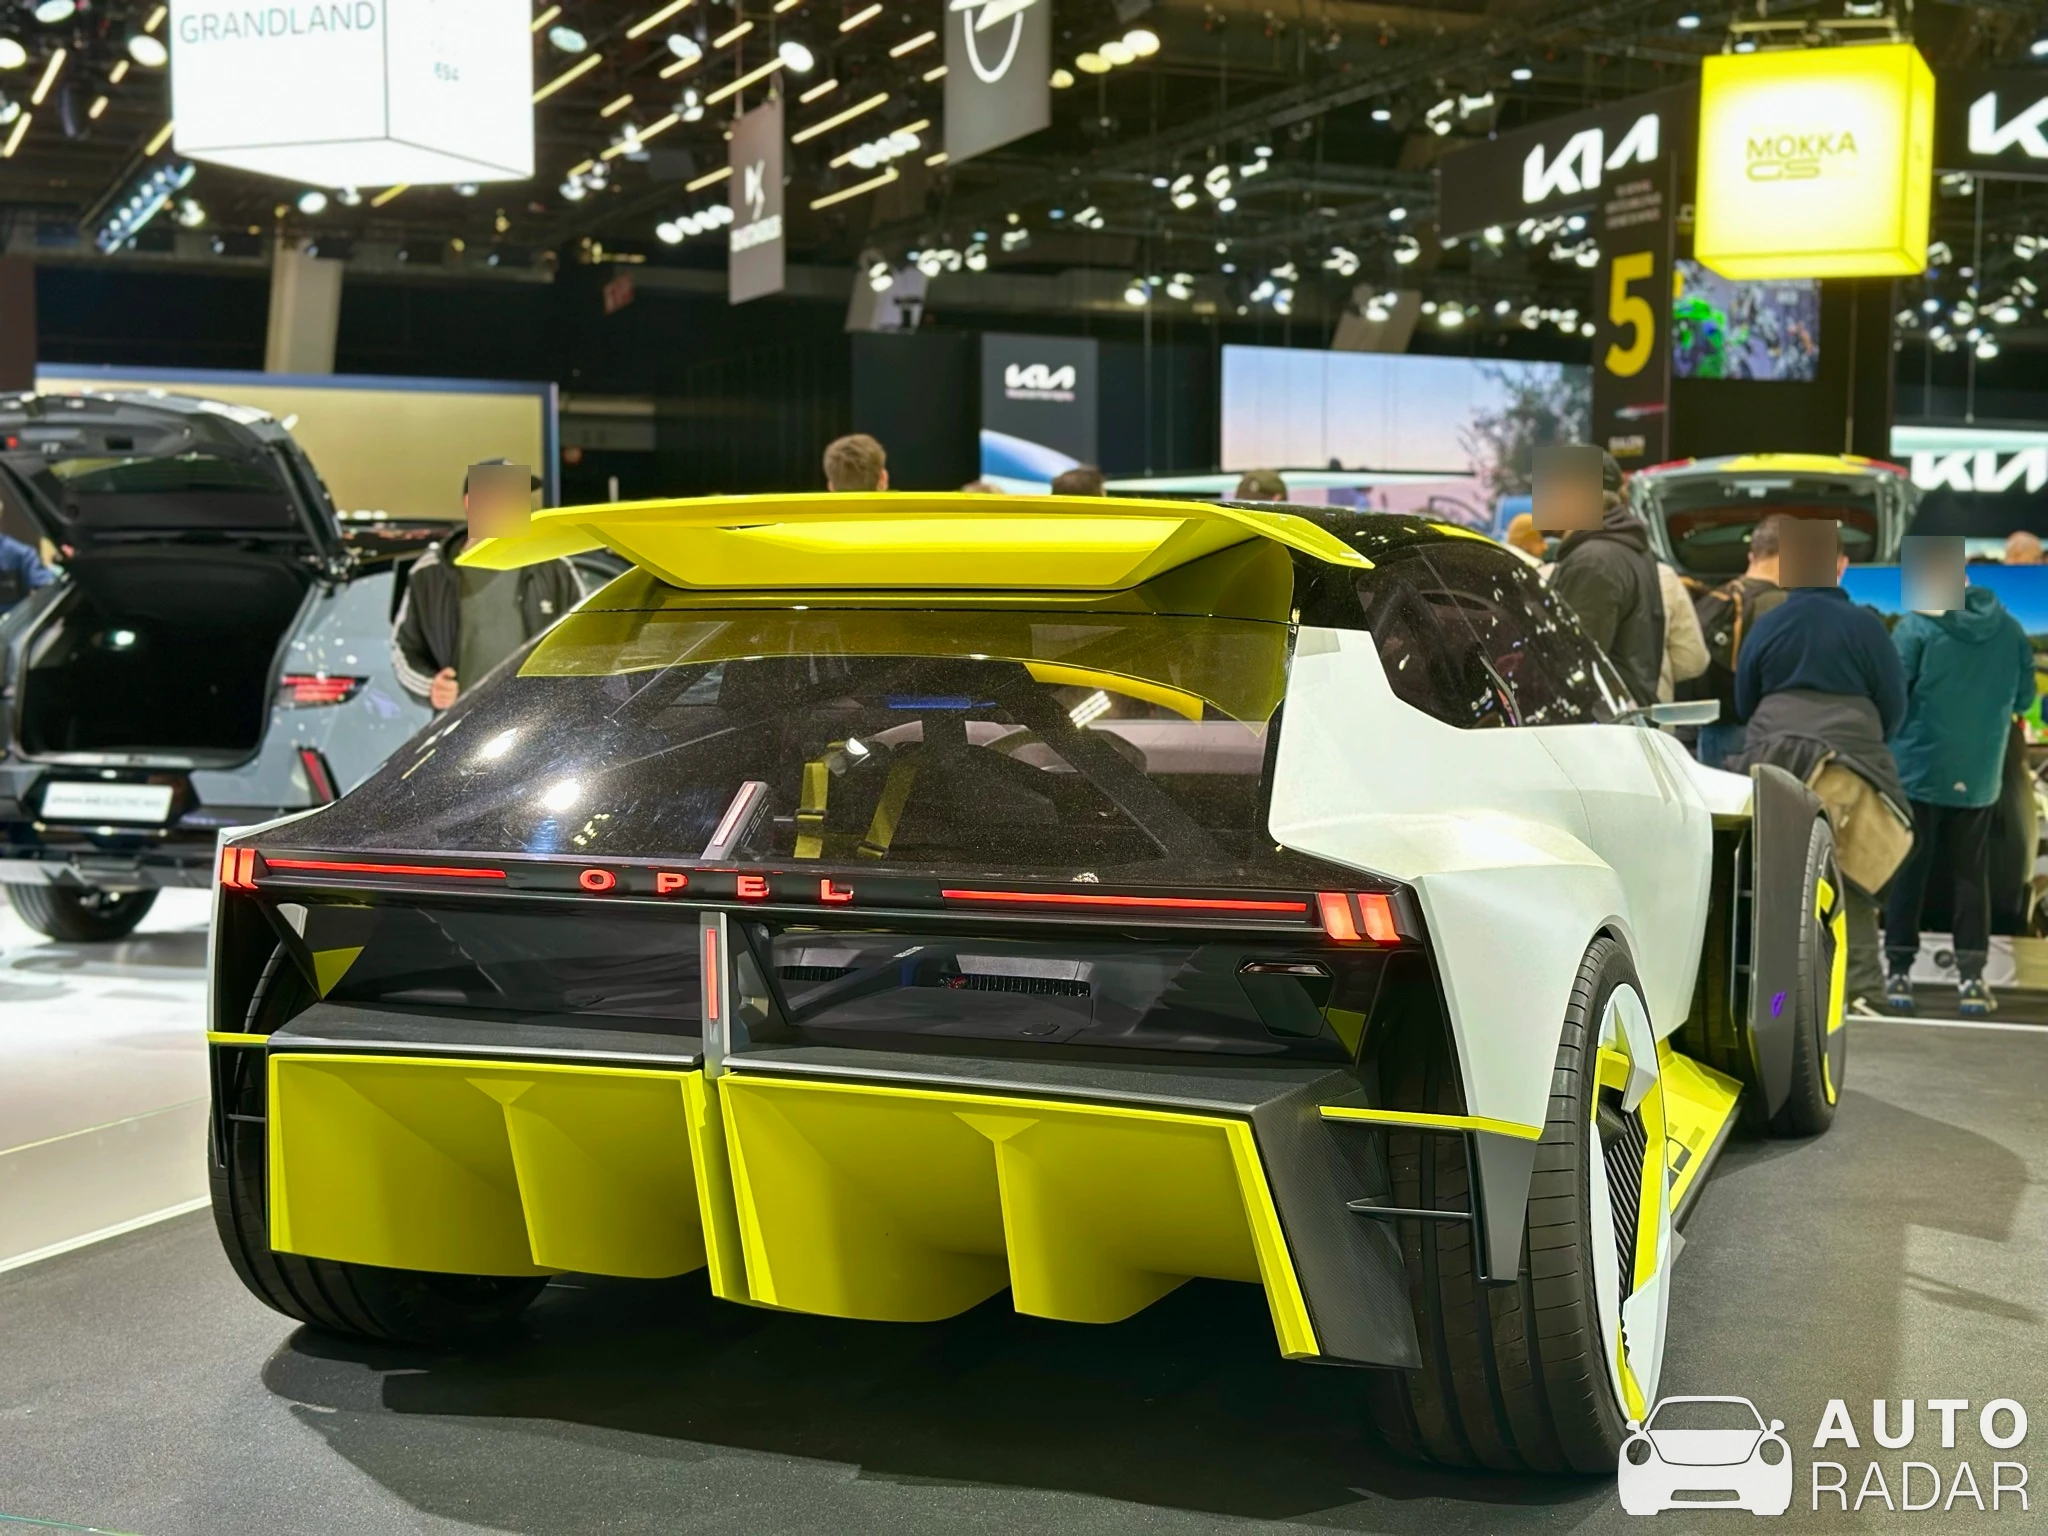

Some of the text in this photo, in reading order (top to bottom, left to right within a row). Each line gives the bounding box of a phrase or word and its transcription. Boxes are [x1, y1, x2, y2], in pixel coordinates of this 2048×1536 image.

[179, 1, 375, 44] GRANDLAND
[1522, 113, 1659, 204] KIA
[1746, 131, 1858, 161] MOKKA
[1605, 251, 1654, 377] 5
[1005, 363, 1076, 390] KIA
[1911, 448, 2048, 494] KIA
[579, 869, 854, 902] OPEL
